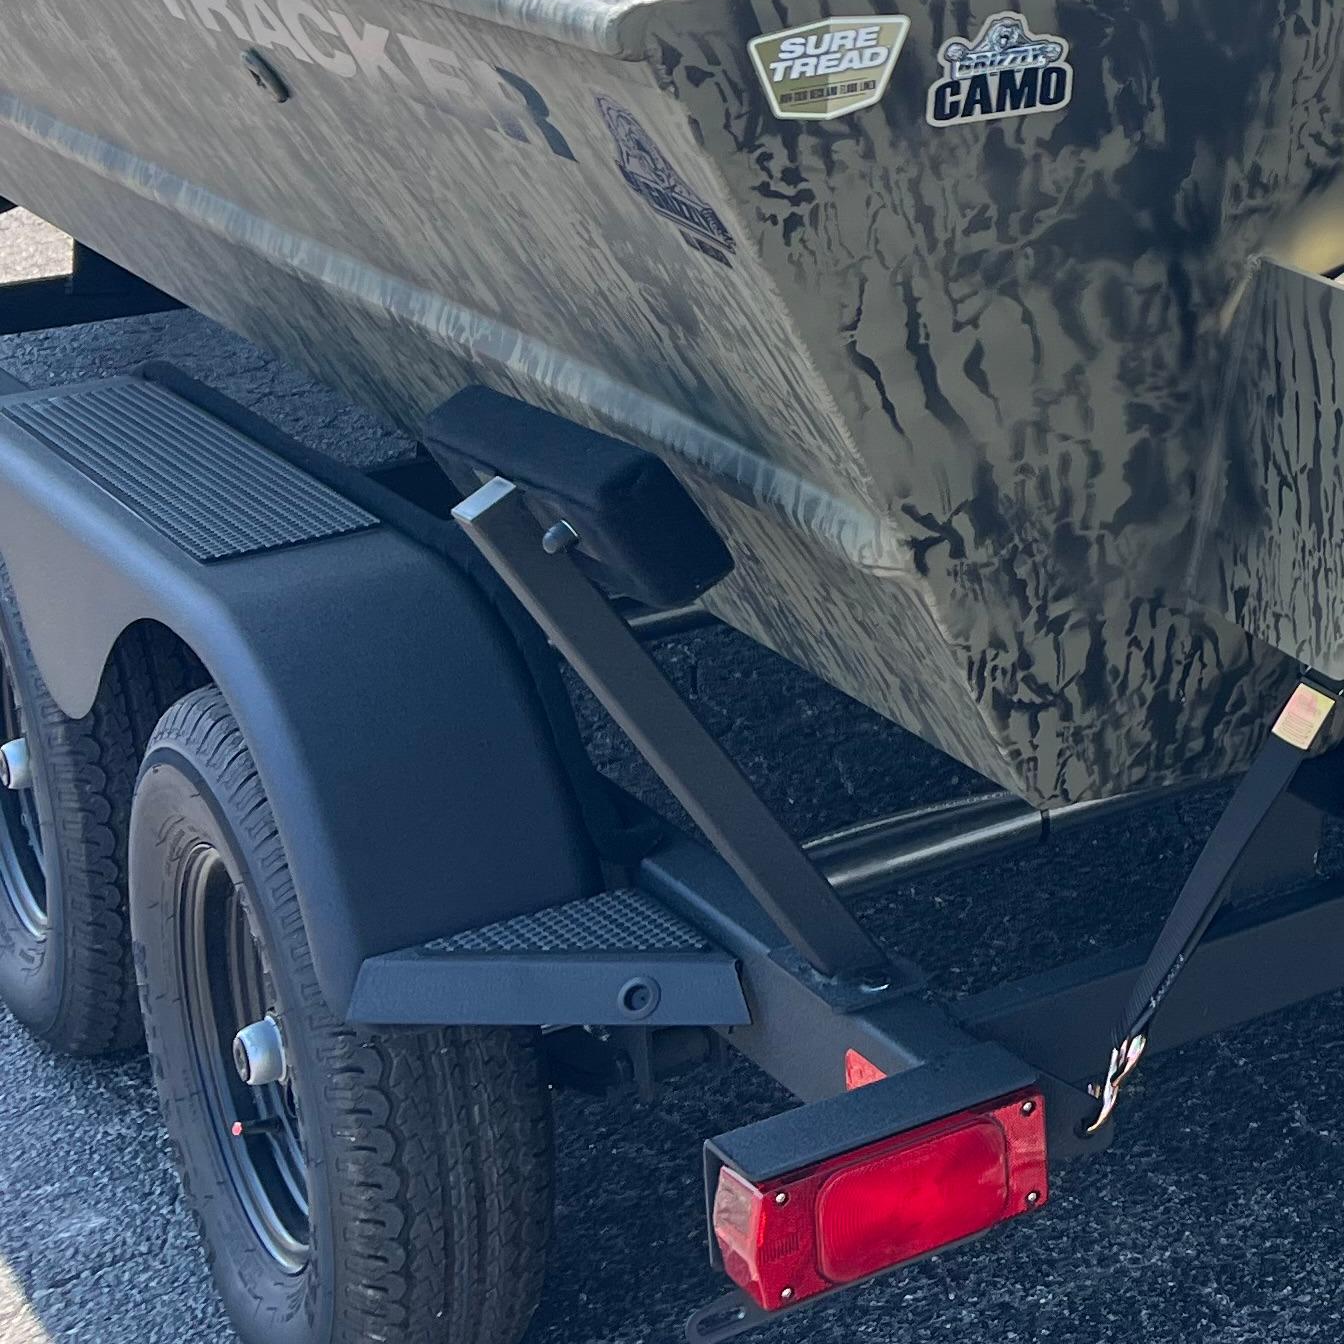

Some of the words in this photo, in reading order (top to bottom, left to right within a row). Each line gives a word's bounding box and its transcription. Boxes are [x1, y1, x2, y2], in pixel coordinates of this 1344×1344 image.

[779, 25, 882, 61] SURE
[769, 45, 890, 83] TREAD
[932, 66, 1069, 122] CAMO
